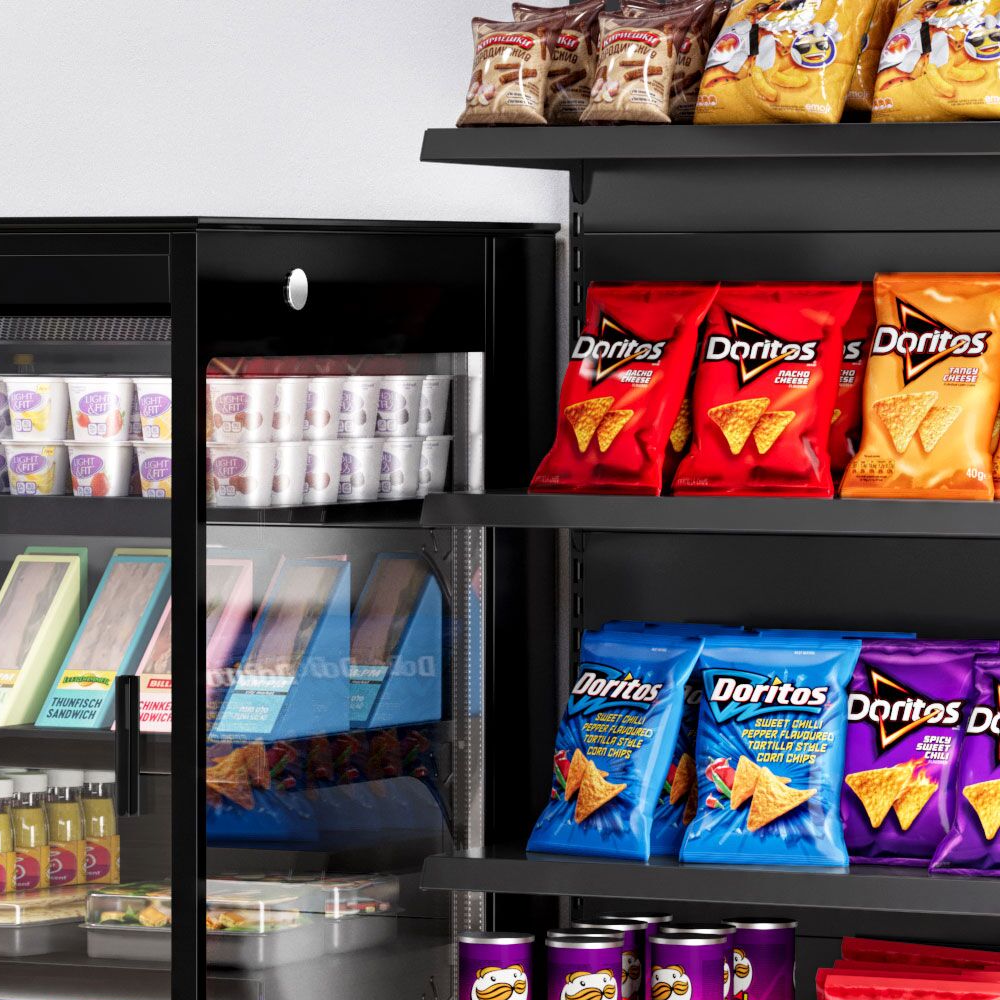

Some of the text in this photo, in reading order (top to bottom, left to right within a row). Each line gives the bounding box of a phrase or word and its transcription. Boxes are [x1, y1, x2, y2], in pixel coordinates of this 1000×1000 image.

[805, 103, 831, 113] emoji
[873, 327, 992, 355] Doritos
[572, 336, 666, 360] Doritos
[706, 336, 818, 361] Doritos
[621, 376, 651, 384] CHEESE
[779, 370, 811, 378] NACHO
[943, 375, 978, 383] CHEESE
[775, 377, 809, 385] CHEESE
[572, 672, 662, 702] Doritos
[711, 677, 829, 707] Doritos
[51, 697, 103, 709] THUNFISCH
[848, 693, 964, 724] Doritos
[46, 708, 97, 720] SANDWICH
[594, 712, 646, 725] SWEET CHILLI
[755, 718, 823, 730] SWEET CHILLI
[582, 722, 654, 739] PEPPER FLAVOURED
[742, 729, 834, 742] PEPPER FLAVOURED
[583, 734, 643, 748] TORTILLA STYLE
[923, 735, 952, 744] SPICY
[748, 740, 827, 753] TORTILLA STYLE
[915, 743, 951, 752] SWEET
[586, 746, 632, 760] CORN CHIPS
[756, 752, 817, 764] CORN CHIPS
[924, 751, 950, 760] CHILI
